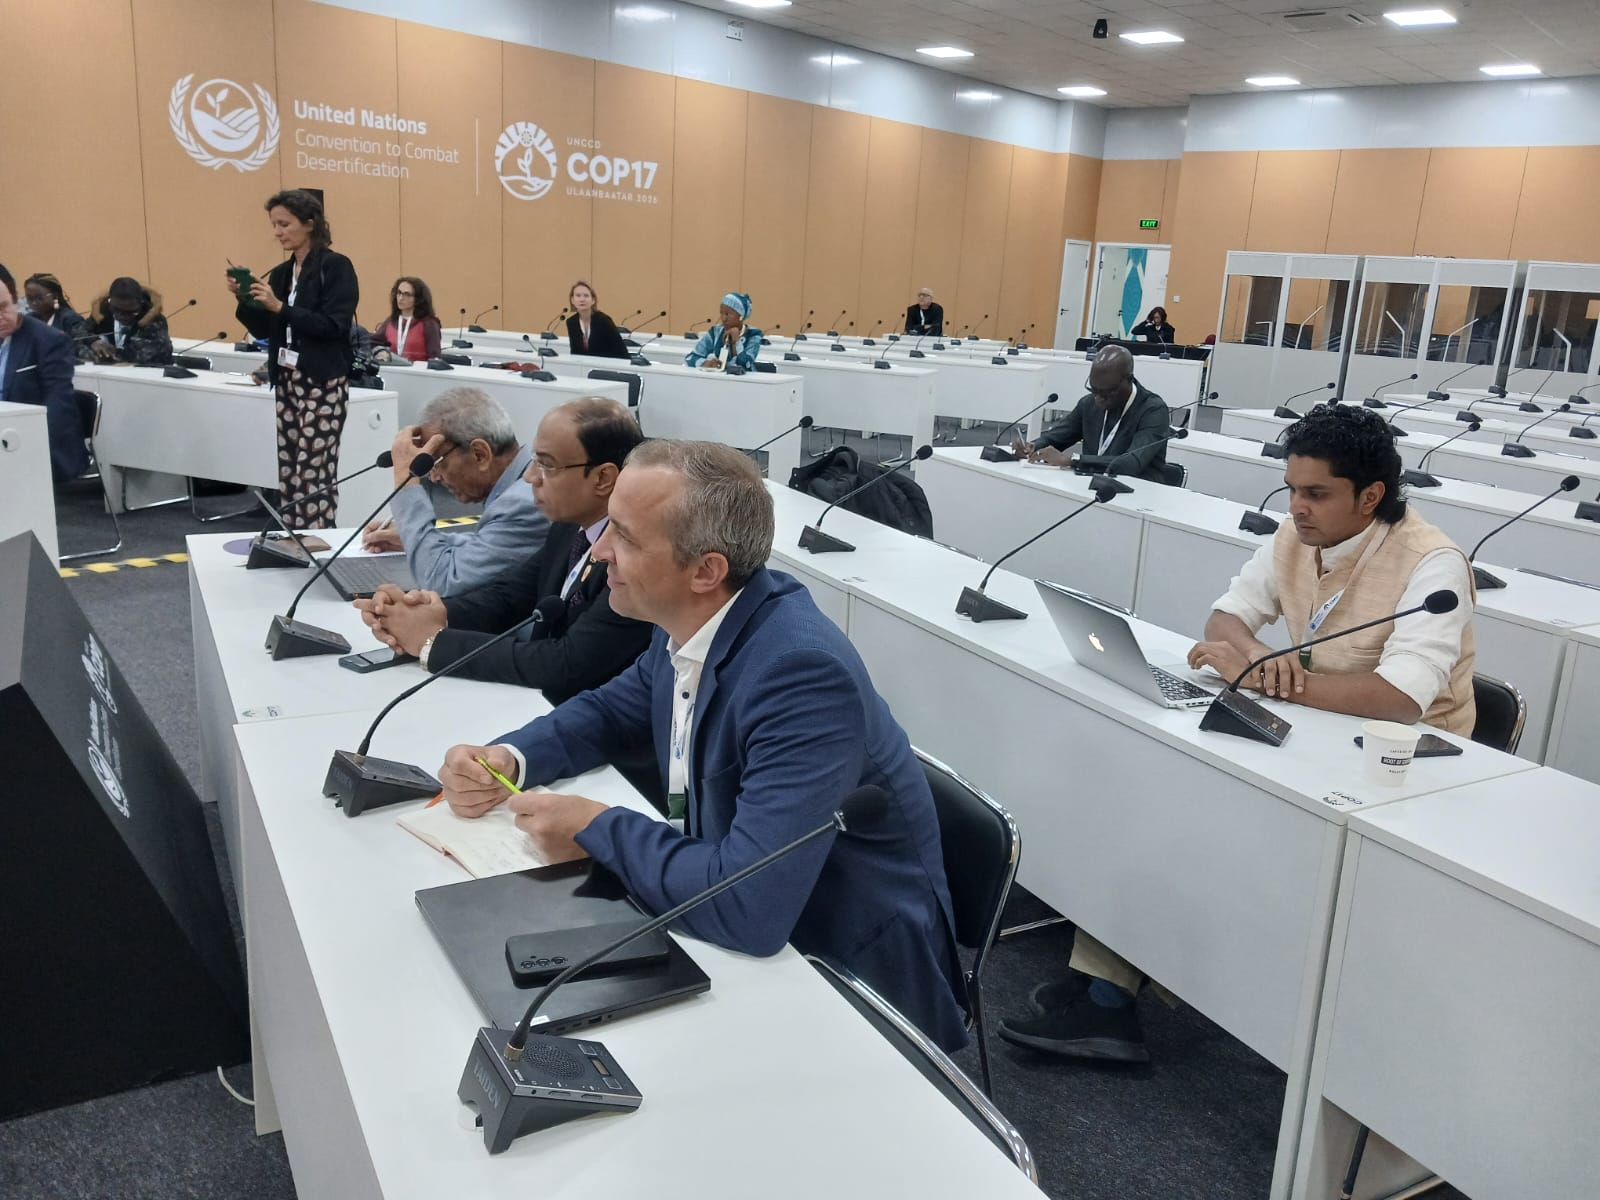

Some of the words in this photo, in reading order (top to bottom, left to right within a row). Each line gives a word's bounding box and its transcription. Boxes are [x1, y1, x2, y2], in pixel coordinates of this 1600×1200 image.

[294, 100, 355, 125] United
[361, 109, 427, 135] Nations
[295, 128, 381, 154] Convention
[386, 141, 401, 157] to
[405, 142, 459, 163] Combat
[566, 136, 601, 149] UNCCD
[296, 151, 409, 179] Desertification
[567, 152, 658, 190] COP17
[566, 187, 633, 201] ULAANBAATAR
